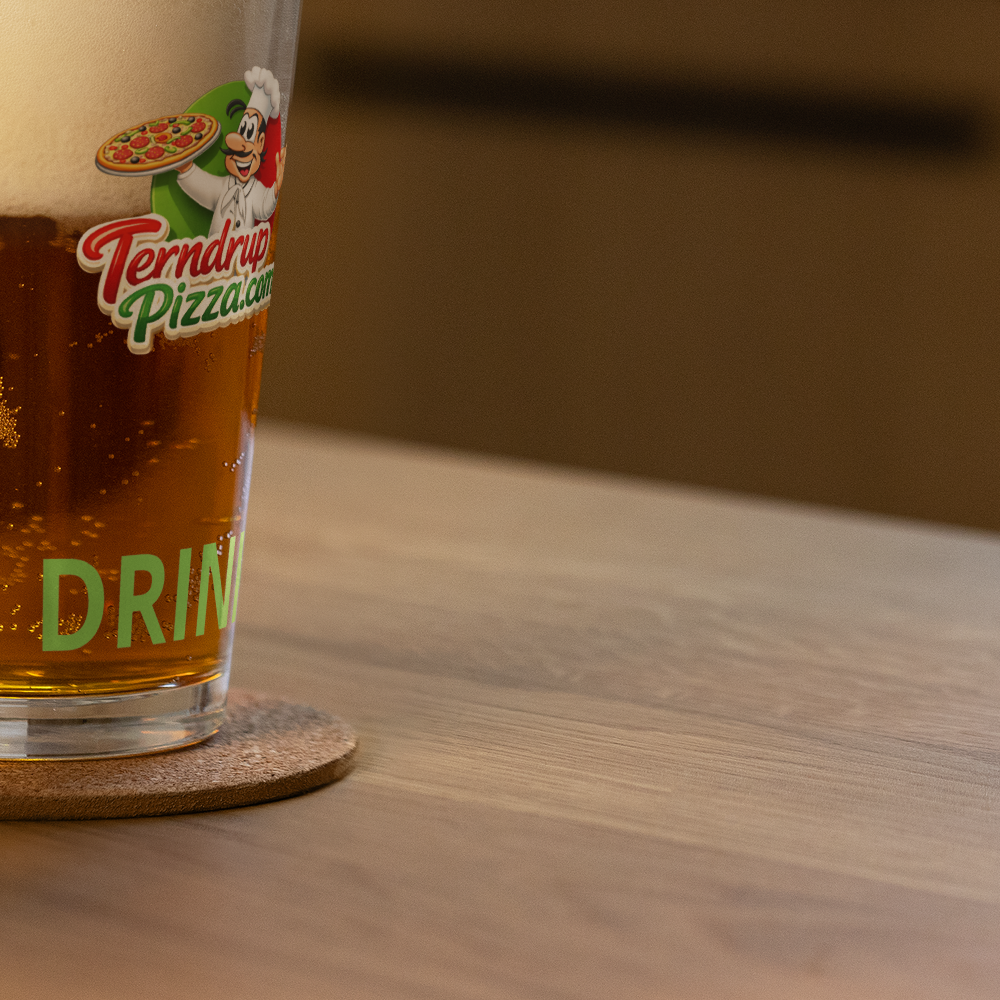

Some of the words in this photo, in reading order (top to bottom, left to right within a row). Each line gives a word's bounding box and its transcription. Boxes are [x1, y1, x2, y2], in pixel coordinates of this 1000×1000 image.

[82, 218, 270, 304] Terndrup
[118, 268, 274, 343] Pizza.com
[42, 531, 245, 652] DRIN
